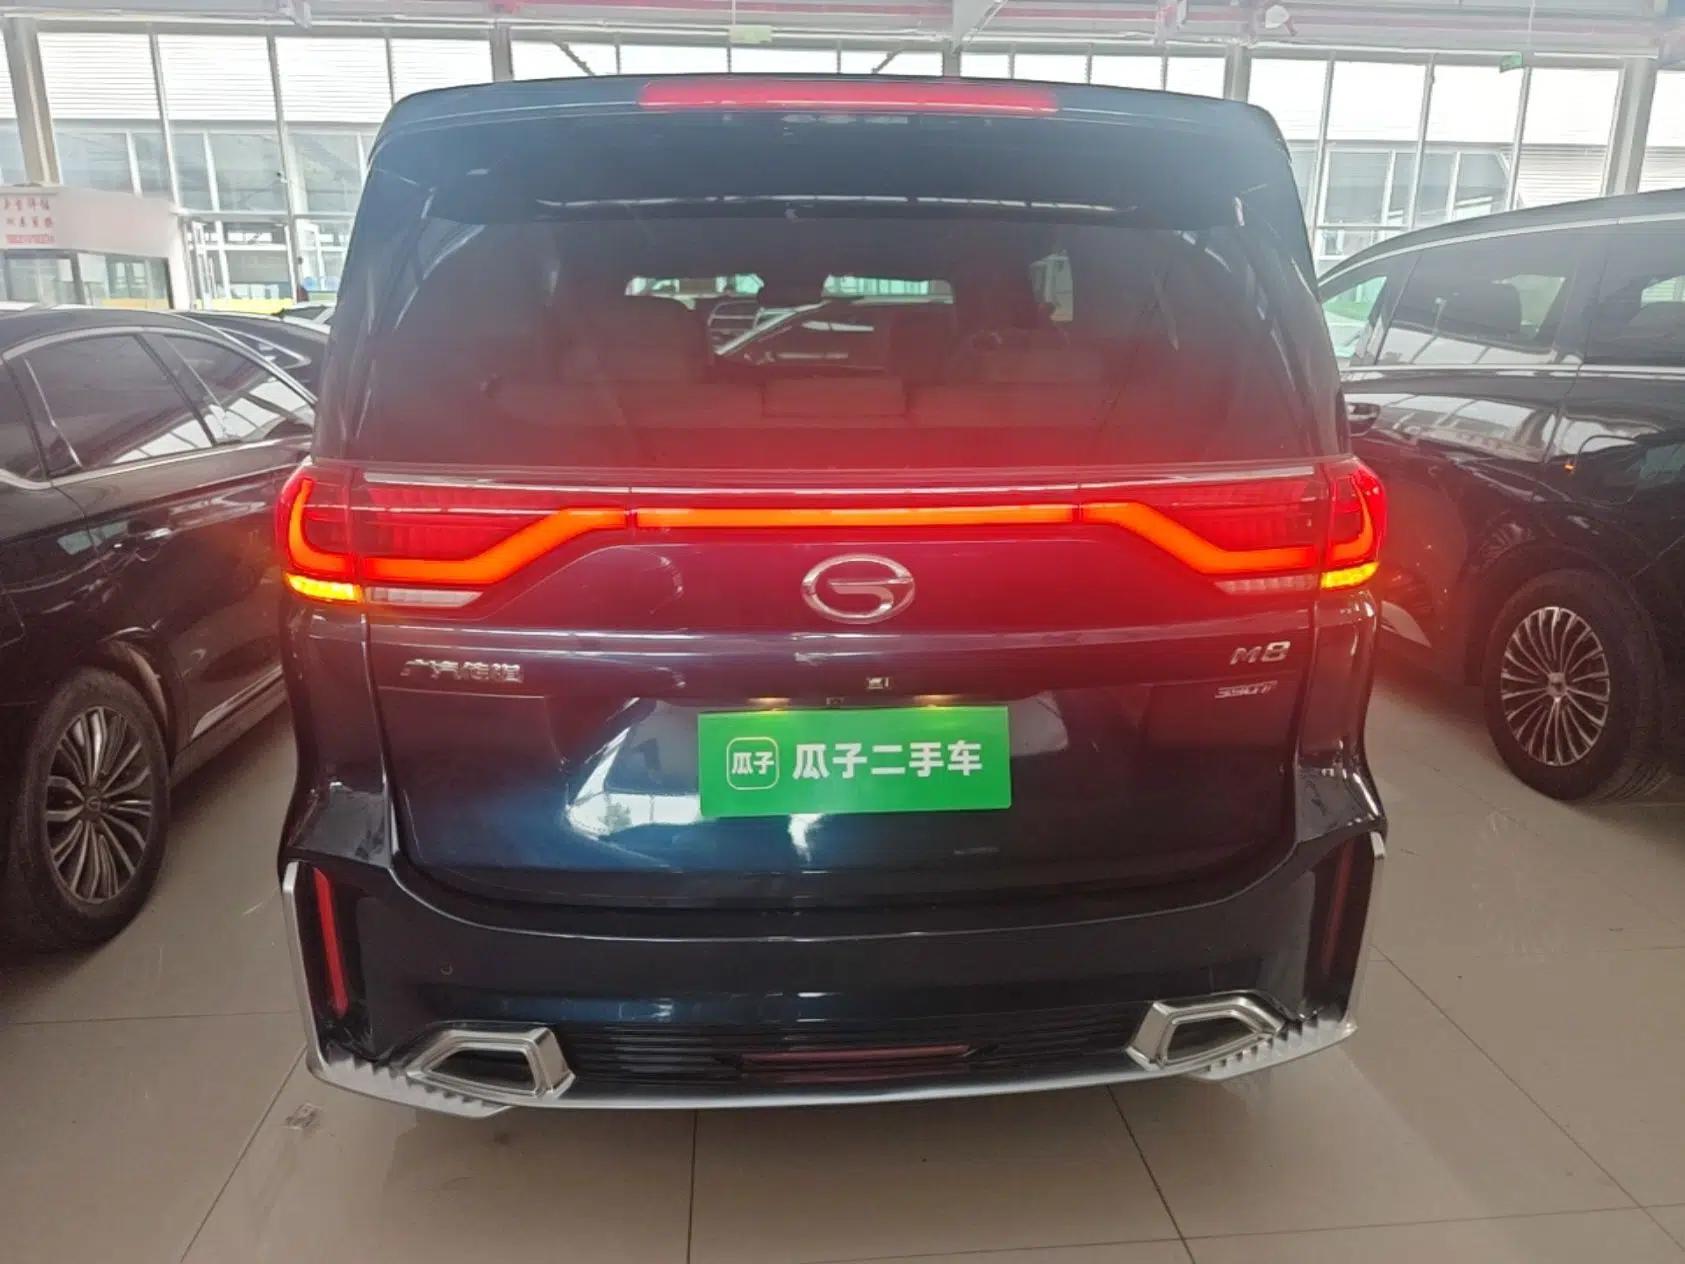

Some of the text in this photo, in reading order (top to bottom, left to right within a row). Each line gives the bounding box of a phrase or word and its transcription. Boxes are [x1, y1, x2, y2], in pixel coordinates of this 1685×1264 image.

[1229, 640, 1291, 665] M8
[731, 739, 983, 780] 瓜子 瓜子二手车
